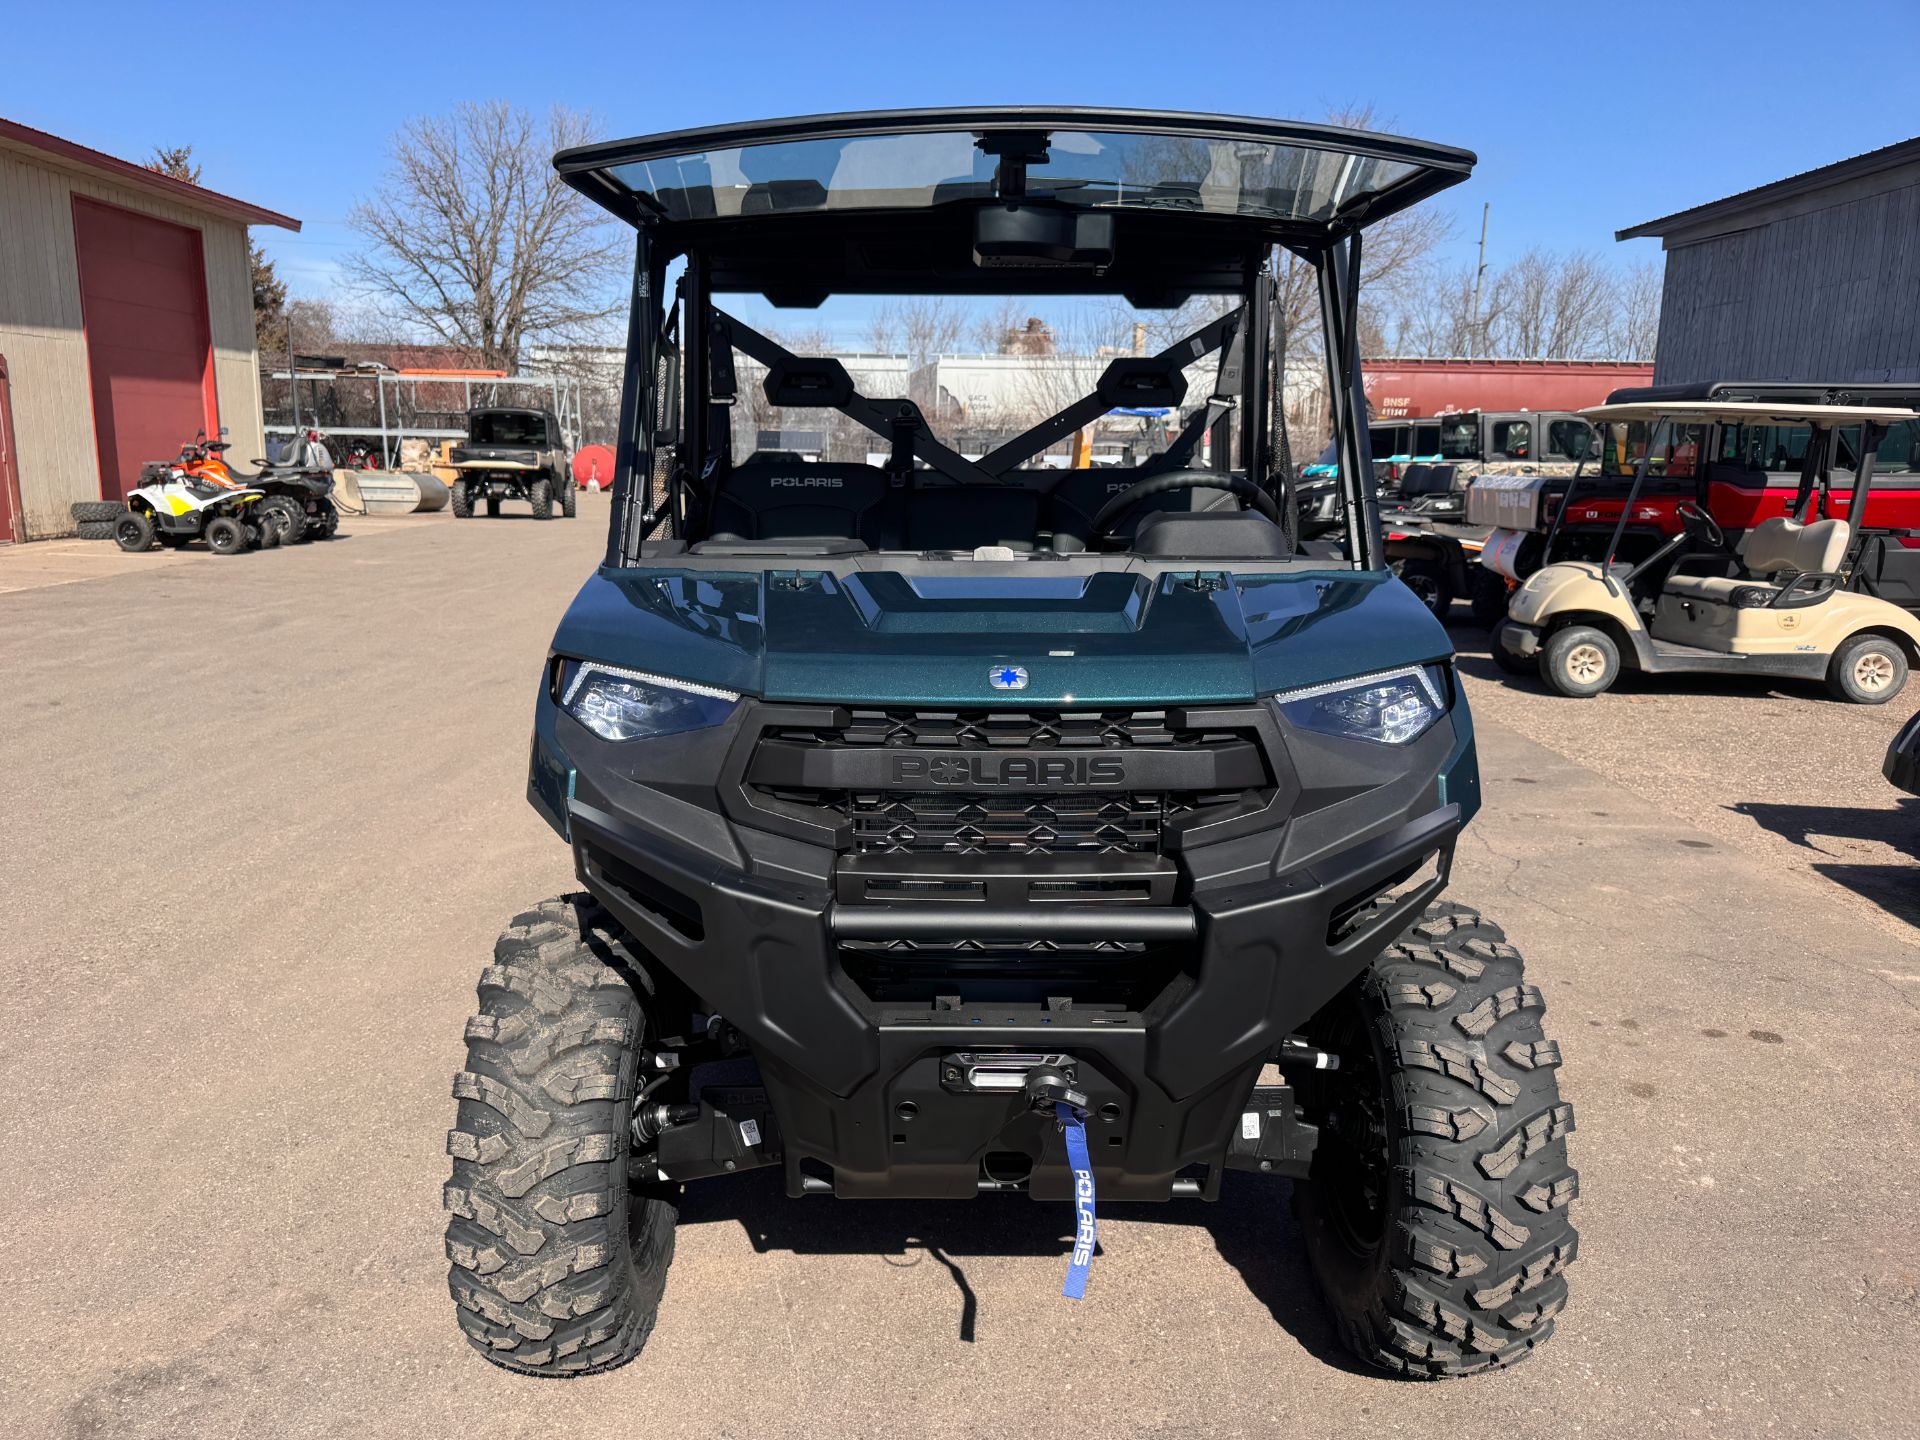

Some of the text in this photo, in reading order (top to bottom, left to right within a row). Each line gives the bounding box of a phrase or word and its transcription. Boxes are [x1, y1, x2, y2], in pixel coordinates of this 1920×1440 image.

[1383, 397, 1411, 407] BNSF
[770, 477, 843, 488] POLARIS
[893, 756, 1125, 786] POLARIS
[1073, 1169, 1094, 1267] POLARIS
